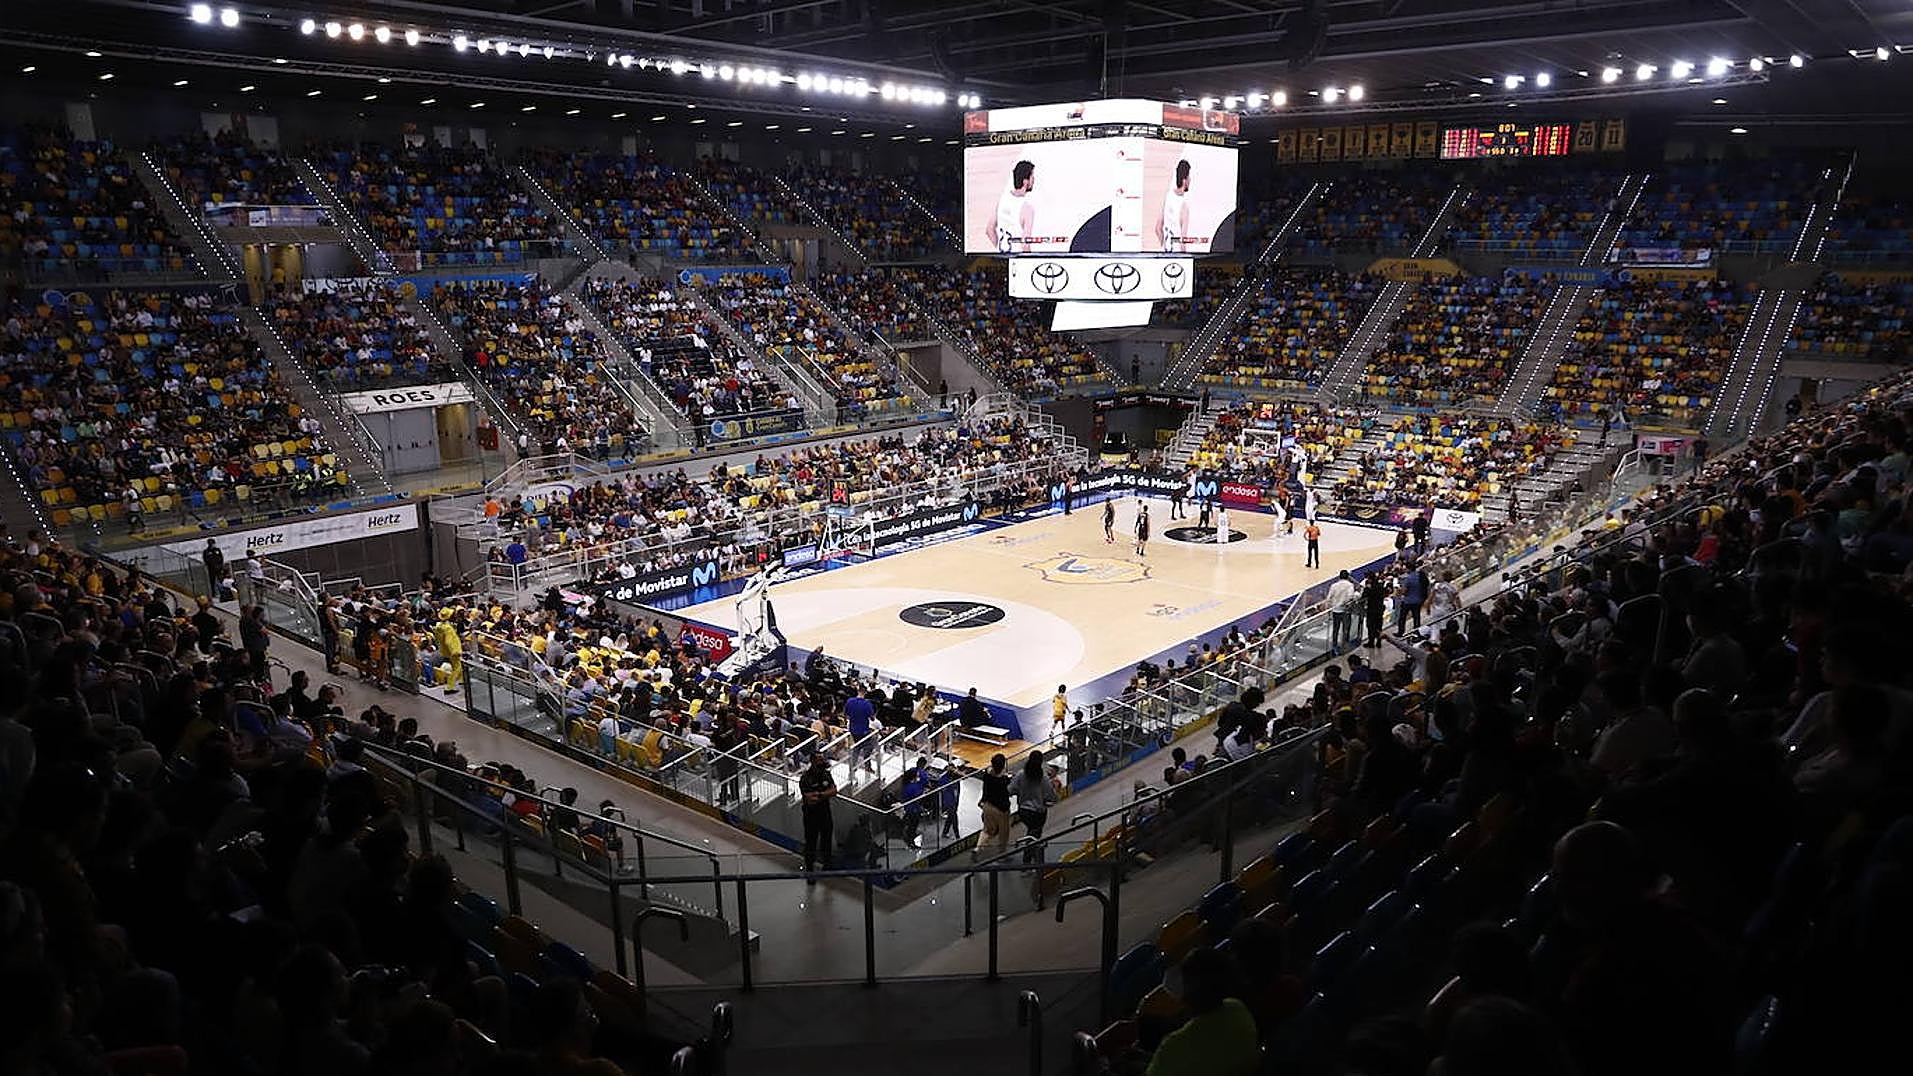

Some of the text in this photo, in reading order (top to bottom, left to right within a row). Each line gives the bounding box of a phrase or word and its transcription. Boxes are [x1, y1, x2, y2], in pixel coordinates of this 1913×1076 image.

[990, 133, 1013, 144] Gran
[1163, 128, 1180, 139] Gran
[372, 390, 435, 406] ROES
[1123, 474, 1136, 485] 5G
[1138, 476, 1149, 487] de
[1151, 477, 1187, 490] Movist
[1222, 484, 1258, 497] endesa
[367, 512, 401, 528] Hertz
[922, 519, 931, 528] de
[931, 511, 962, 526] Movistar
[246, 532, 284, 548] Hertz
[616, 587, 633, 600] de
[635, 573, 689, 595] Movistar
